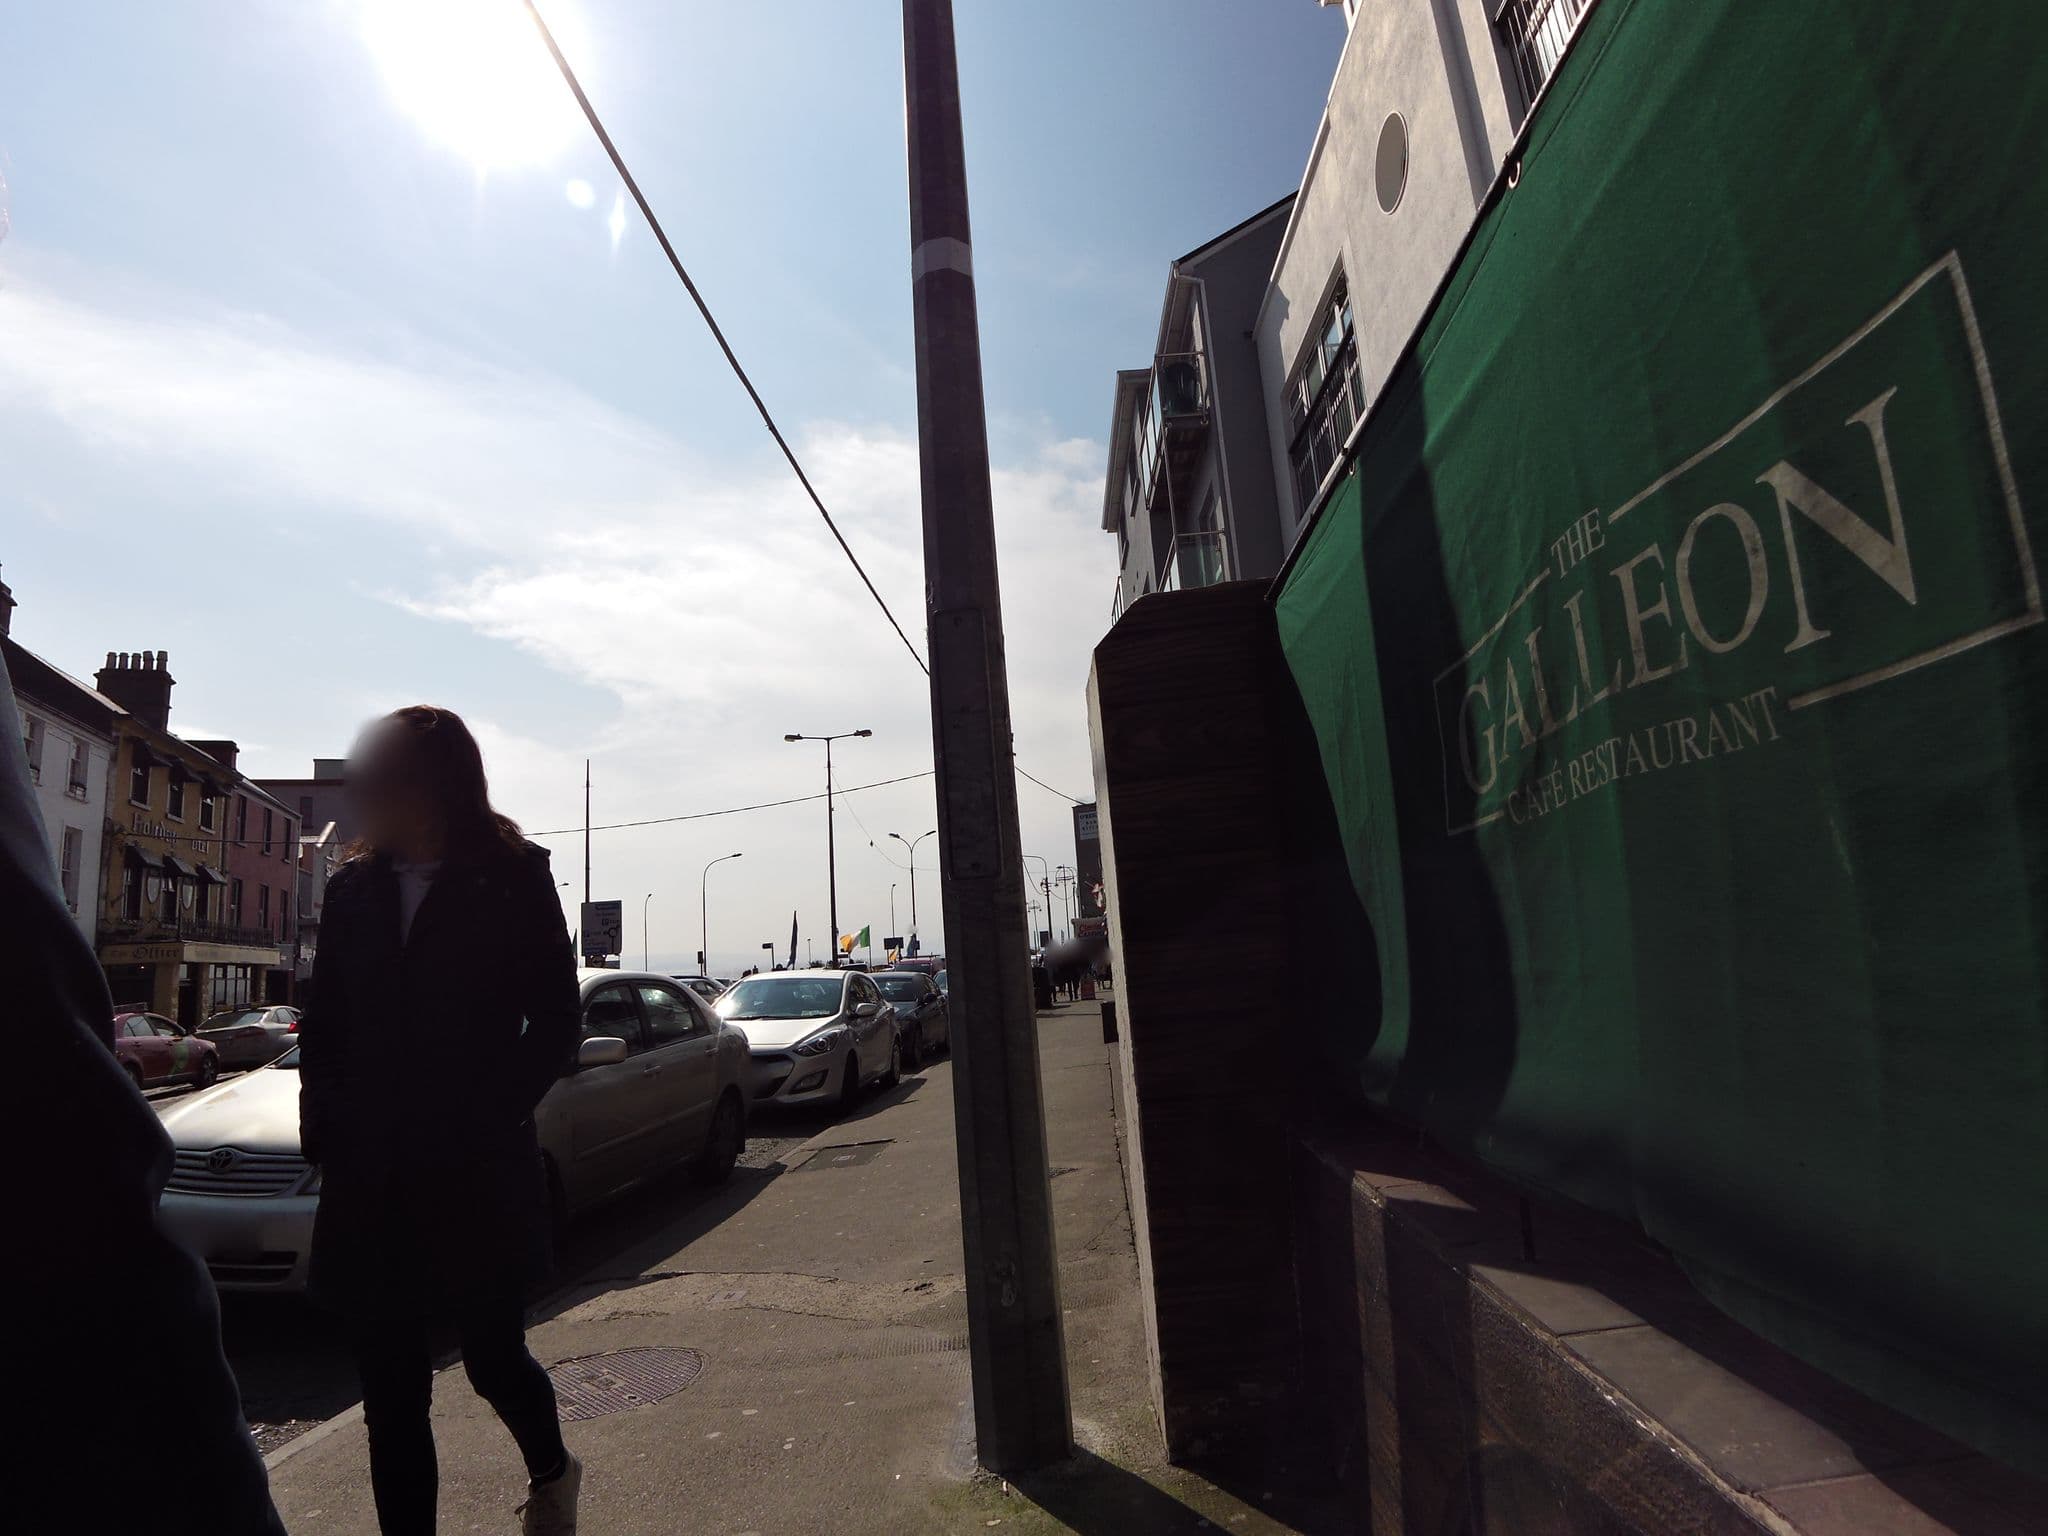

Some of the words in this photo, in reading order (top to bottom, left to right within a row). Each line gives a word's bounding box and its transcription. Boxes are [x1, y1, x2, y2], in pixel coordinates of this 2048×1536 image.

[1458, 386, 1917, 796] GALLEON
[1551, 508, 1606, 579] THE
[1507, 760, 1565, 825] CAFÉ
[1569, 687, 1781, 800] RESTAURANT
